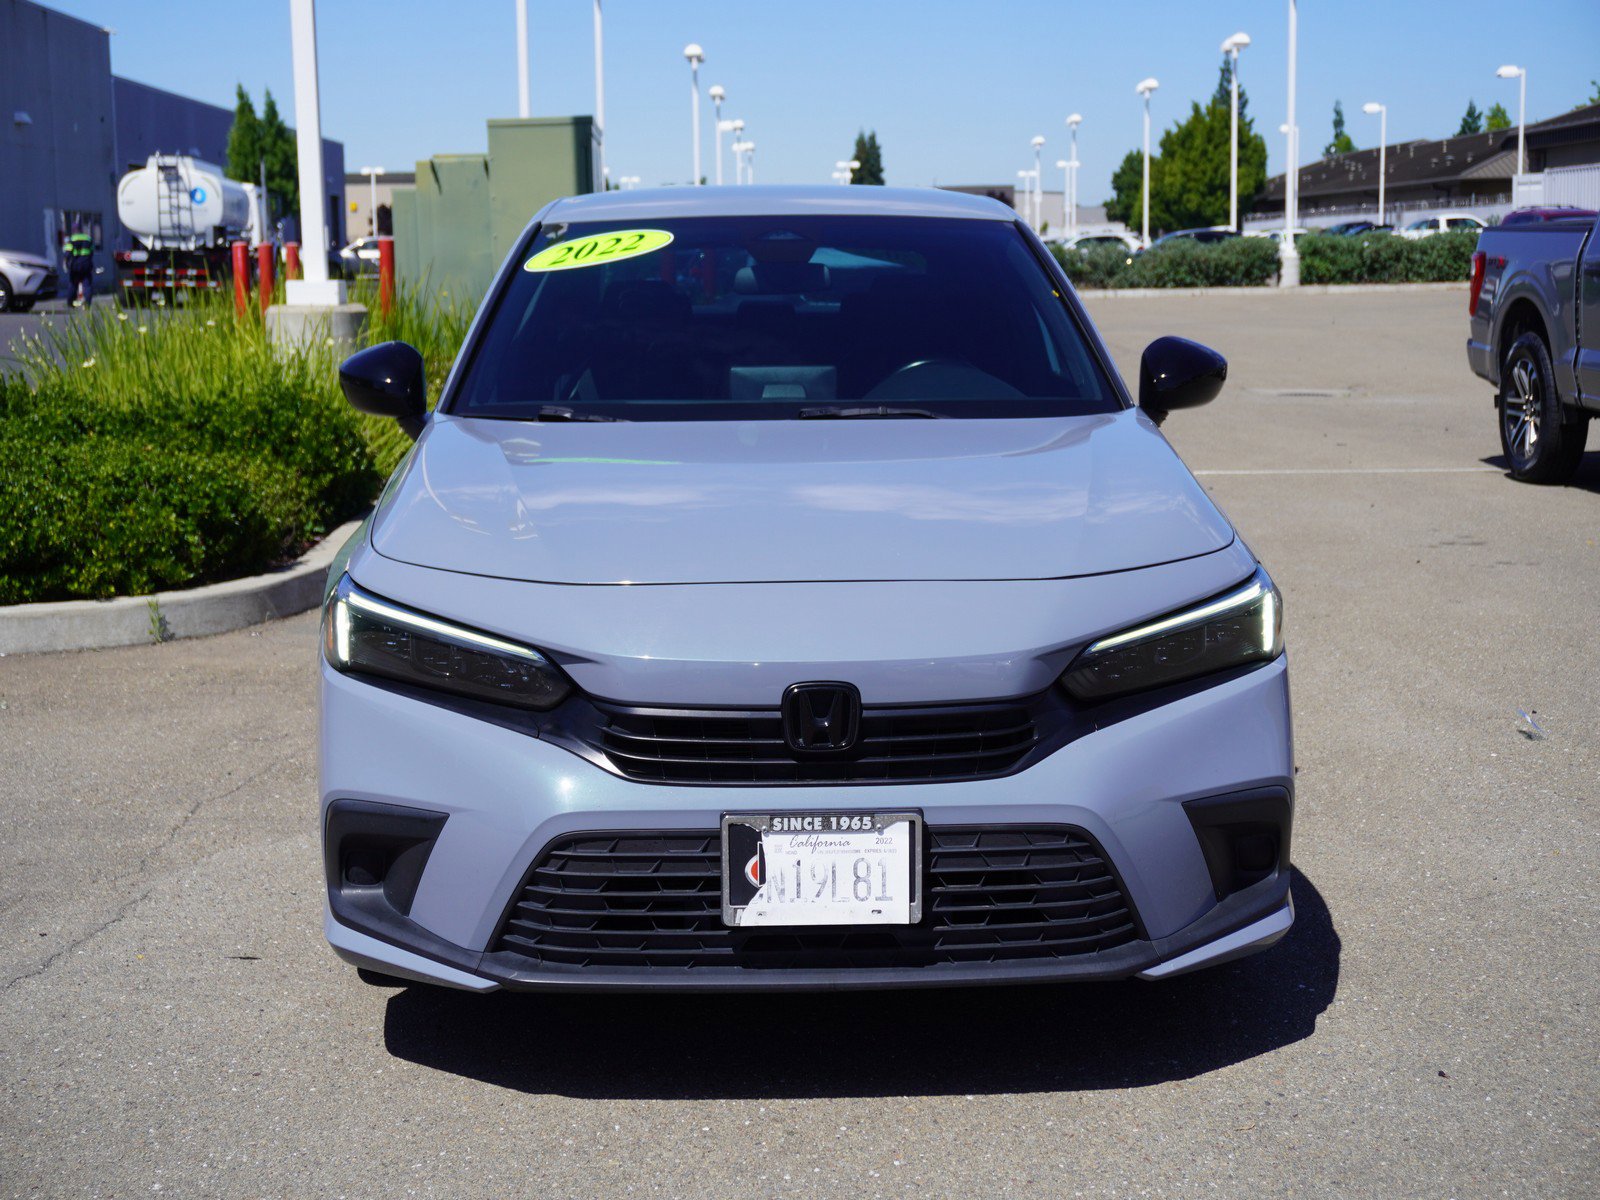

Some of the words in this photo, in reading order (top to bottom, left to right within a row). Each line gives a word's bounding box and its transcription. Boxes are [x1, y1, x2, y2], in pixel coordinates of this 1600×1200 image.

[547, 233, 646, 266] 2022
[772, 816, 823, 832] SINCE
[830, 816, 873, 831] 1965
[789, 834, 851, 854] California
[875, 837, 893, 845] 2022
[752, 857, 893, 904] N19L81
